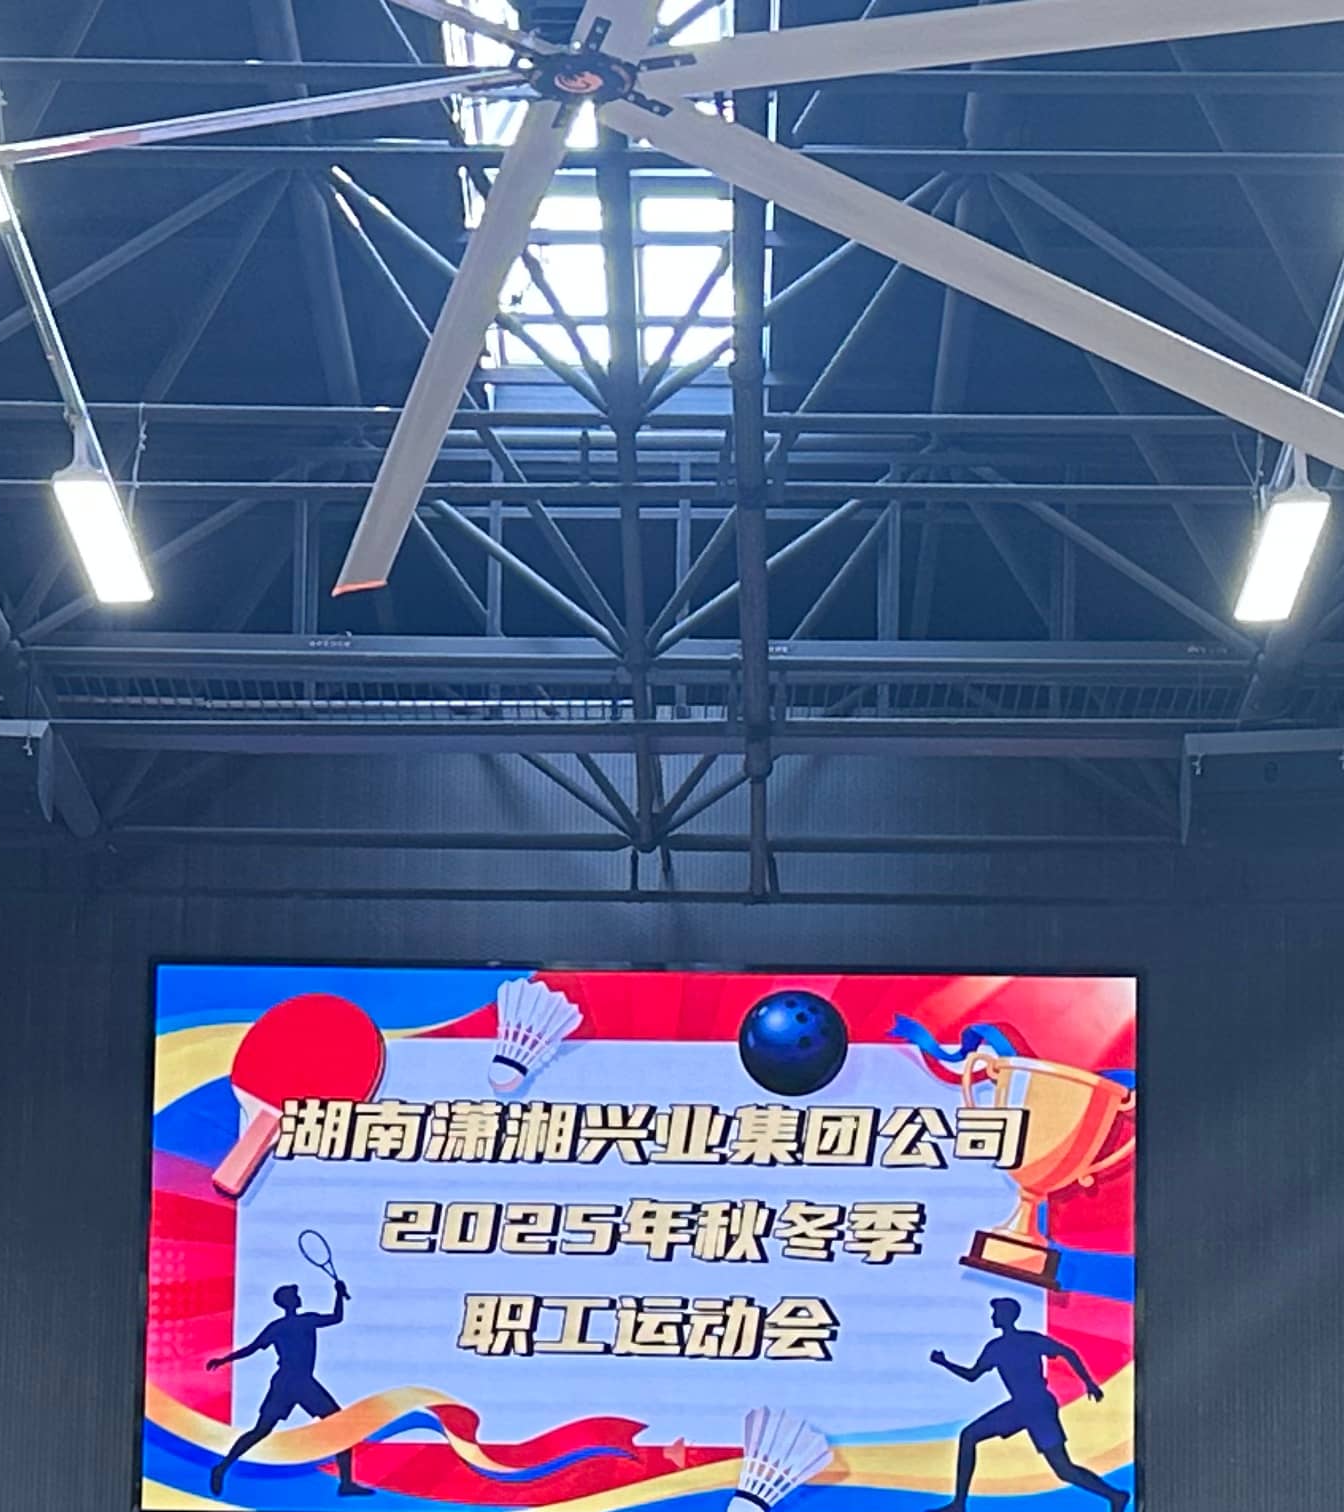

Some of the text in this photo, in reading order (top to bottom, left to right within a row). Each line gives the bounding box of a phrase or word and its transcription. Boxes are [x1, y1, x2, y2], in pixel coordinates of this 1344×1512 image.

[275, 1098, 1030, 1169] 湖南潇湘兴业集团公司
[380, 1198, 927, 1264] 2025年秋冬季
[457, 1294, 840, 1361] 职工运动会
